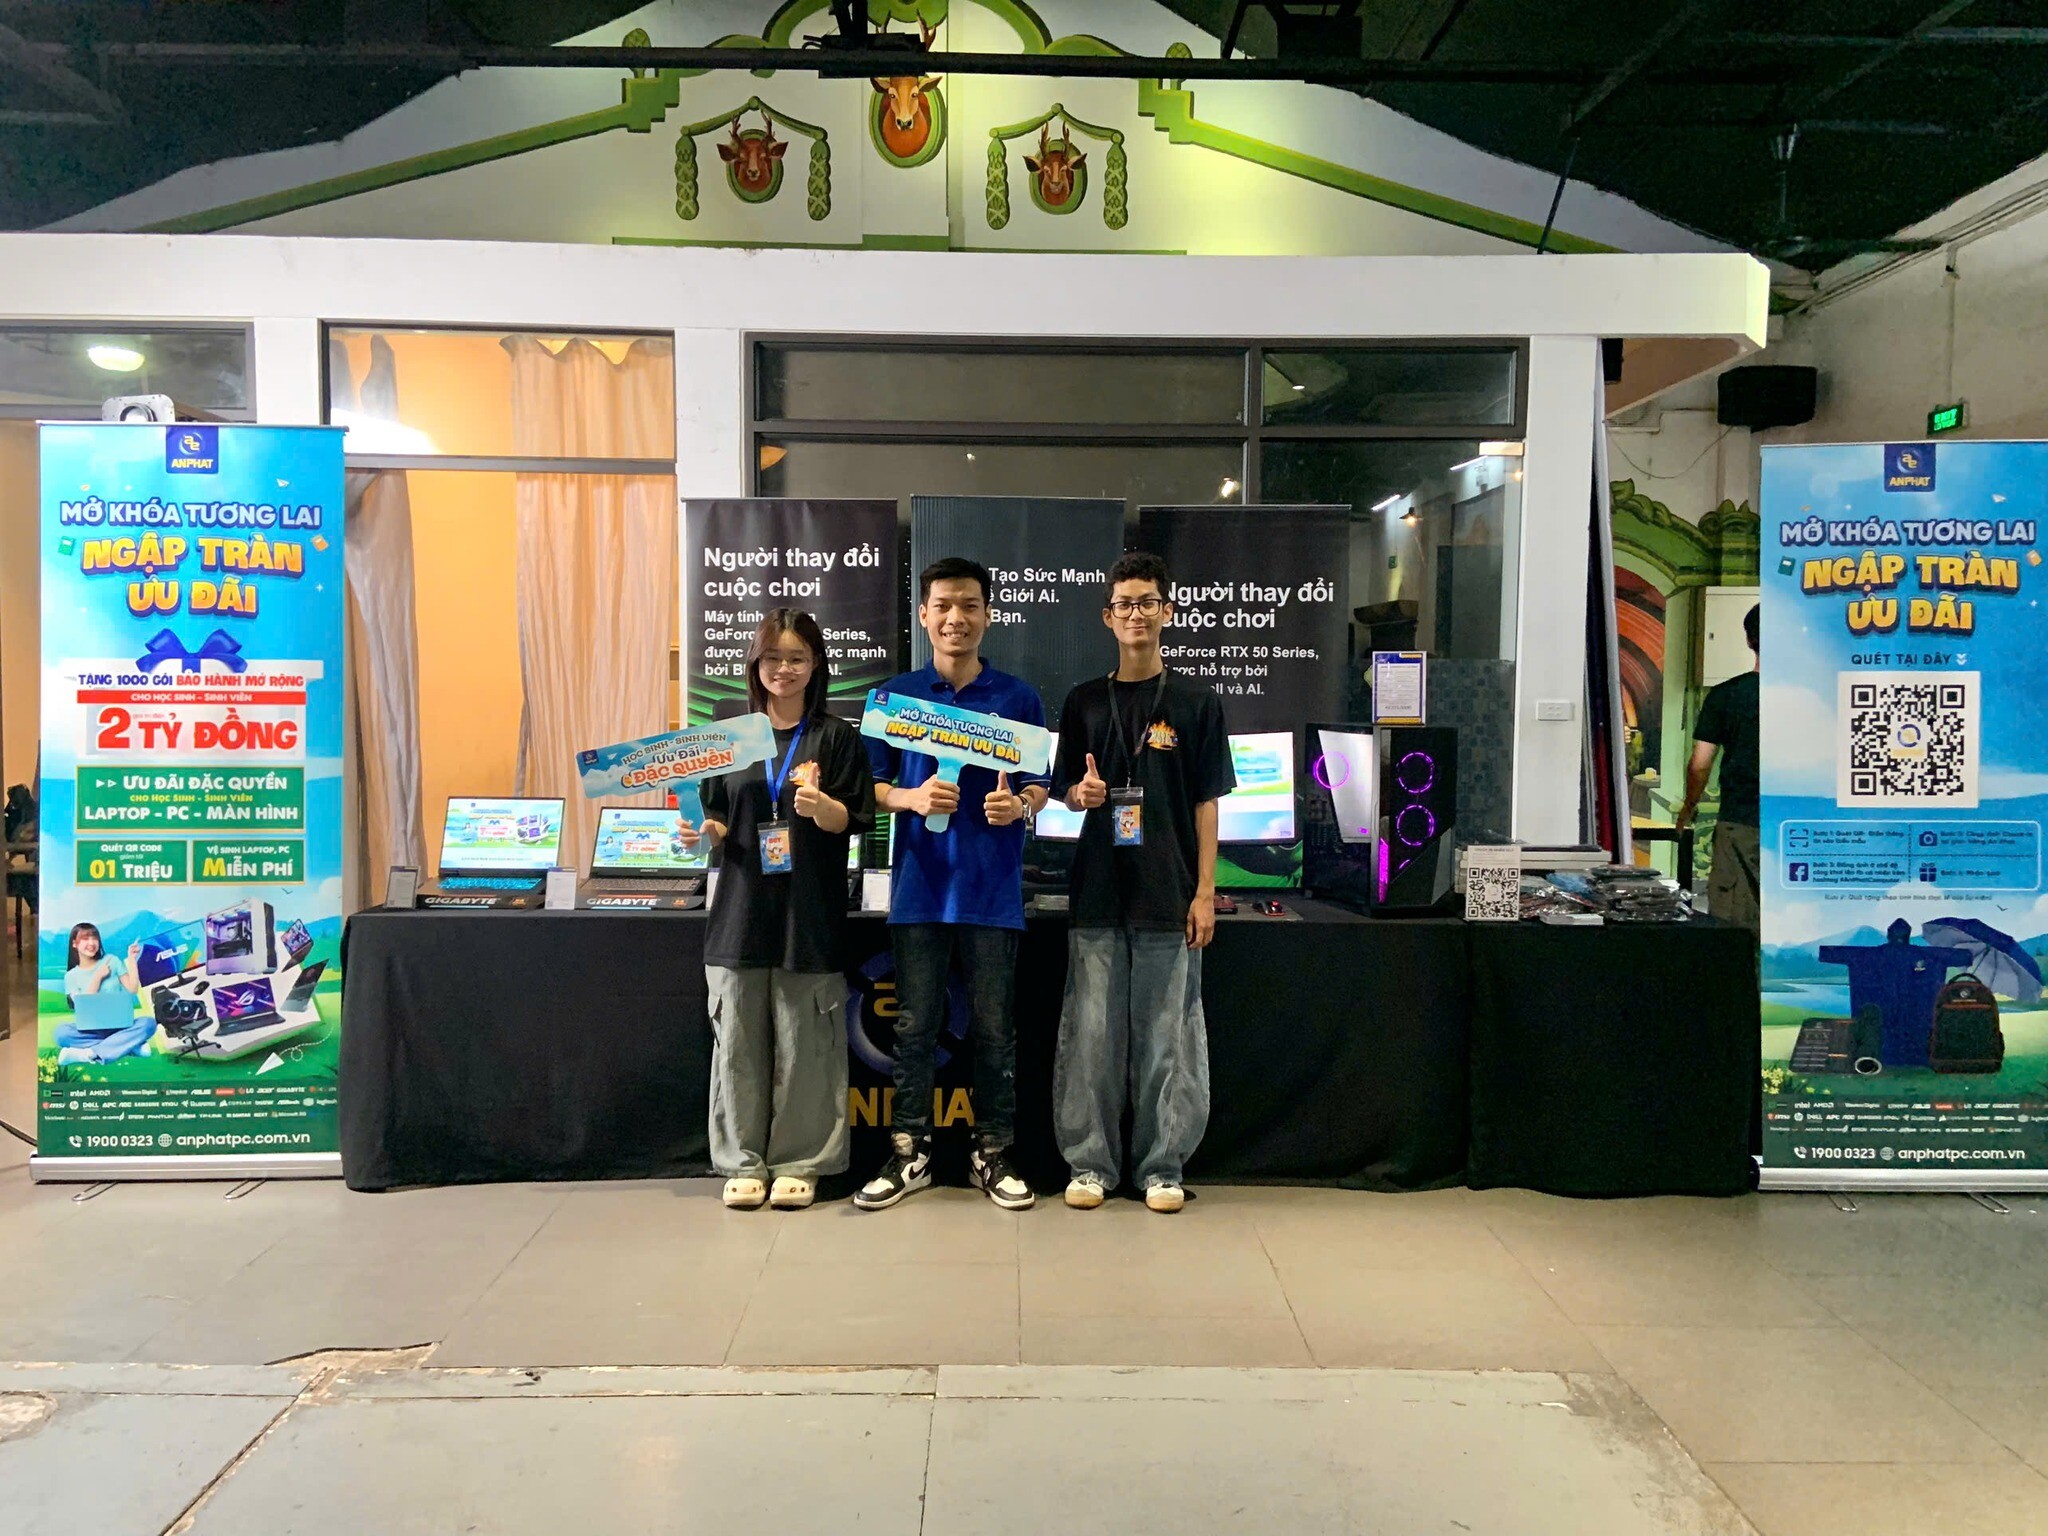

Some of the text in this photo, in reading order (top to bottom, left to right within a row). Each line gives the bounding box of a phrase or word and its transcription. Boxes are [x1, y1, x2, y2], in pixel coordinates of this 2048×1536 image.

[171, 458, 214, 470] ANPHAT
[1888, 476, 1931, 488] ANPHAT
[61, 497, 322, 527] MỞ KHÓA TƯƠNG LAI
[1781, 516, 2037, 545] MỞ KHÓA TƯƠNG LAI
[83, 532, 304, 574] NGẬP TRÀN
[704, 543, 880, 571] Người thay đổi
[988, 567, 1106, 586] Tạo Sức Mạnh
[1802, 549, 2020, 592] NGẬP TRÀN
[127, 578, 180, 613] ƯU
[704, 576, 822, 602] cuộc chơi
[999, 587, 1034, 603] Giới
[1037, 589, 1060, 603] Ai.
[1240, 582, 1291, 608] thay
[1297, 577, 1334, 602] đổi
[704, 610, 765, 626] Máy tính
[990, 608, 1026, 626] Bạn.
[1222, 608, 1275, 628] chơi
[1846, 593, 1899, 632] ƯU
[704, 627, 871, 642] GeForc Series,
[704, 645, 744, 661] được
[846, 646, 887, 661] mạnh
[1159, 645, 1319, 661] GeForce RTX 50 Series,
[1851, 651, 1951, 668] QUÉT TẠI ĐÂY
[704, 663, 729, 676] bởi
[1199, 662, 1217, 676] hỗ
[1220, 665, 1243, 679] trợ
[78, 673, 112, 688] TẶNG
[116, 674, 148, 686] 1000
[153, 672, 173, 686] GÓI
[176, 672, 201, 687] BẢO
[204, 672, 242, 687] HÀNH
[270, 674, 304, 689] RỘNG
[1227, 684, 1244, 695] và
[1246, 683, 1265, 695] AI.
[131, 693, 150, 702] CHO
[174, 693, 196, 702] SINH
[204, 692, 228, 702] SINH
[97, 707, 298, 751] 2 TỶ ĐỒNG
[920, 709, 953, 730] KHÓA
[953, 720, 994, 738] TƯƠNG
[994, 730, 1014, 743] LAI
[886, 721, 928, 742] NGẬP
[930, 728, 971, 750] TRÀN
[123, 771, 287, 793] ƯU ĐÃI ĐẶC QUYỀN
[130, 794, 150, 802] CHO
[174, 794, 195, 802] SINH
[204, 794, 227, 802] SINH
[84, 806, 150, 820] LAPTOP
[166, 806, 190, 820] PC
[206, 803, 251, 820] MÀN
[255, 803, 299, 820] HÌNH
[100, 842, 163, 853] QUÉT QR CODE
[242, 845, 277, 856] LAPTOP,
[278, 845, 291, 854] PC
[89, 859, 173, 882] 01 TRIỆU
[203, 851, 294, 878] MIỄN PHÍ
[424, 896, 498, 905] GIGABYTE
[586, 898, 657, 906] GIGABYTE
[86, 1132, 311, 1150] 1900 0323 anphatpc.com.vn
[1811, 1147, 2026, 1163] 1900 0323 anphatpc.com.vn
